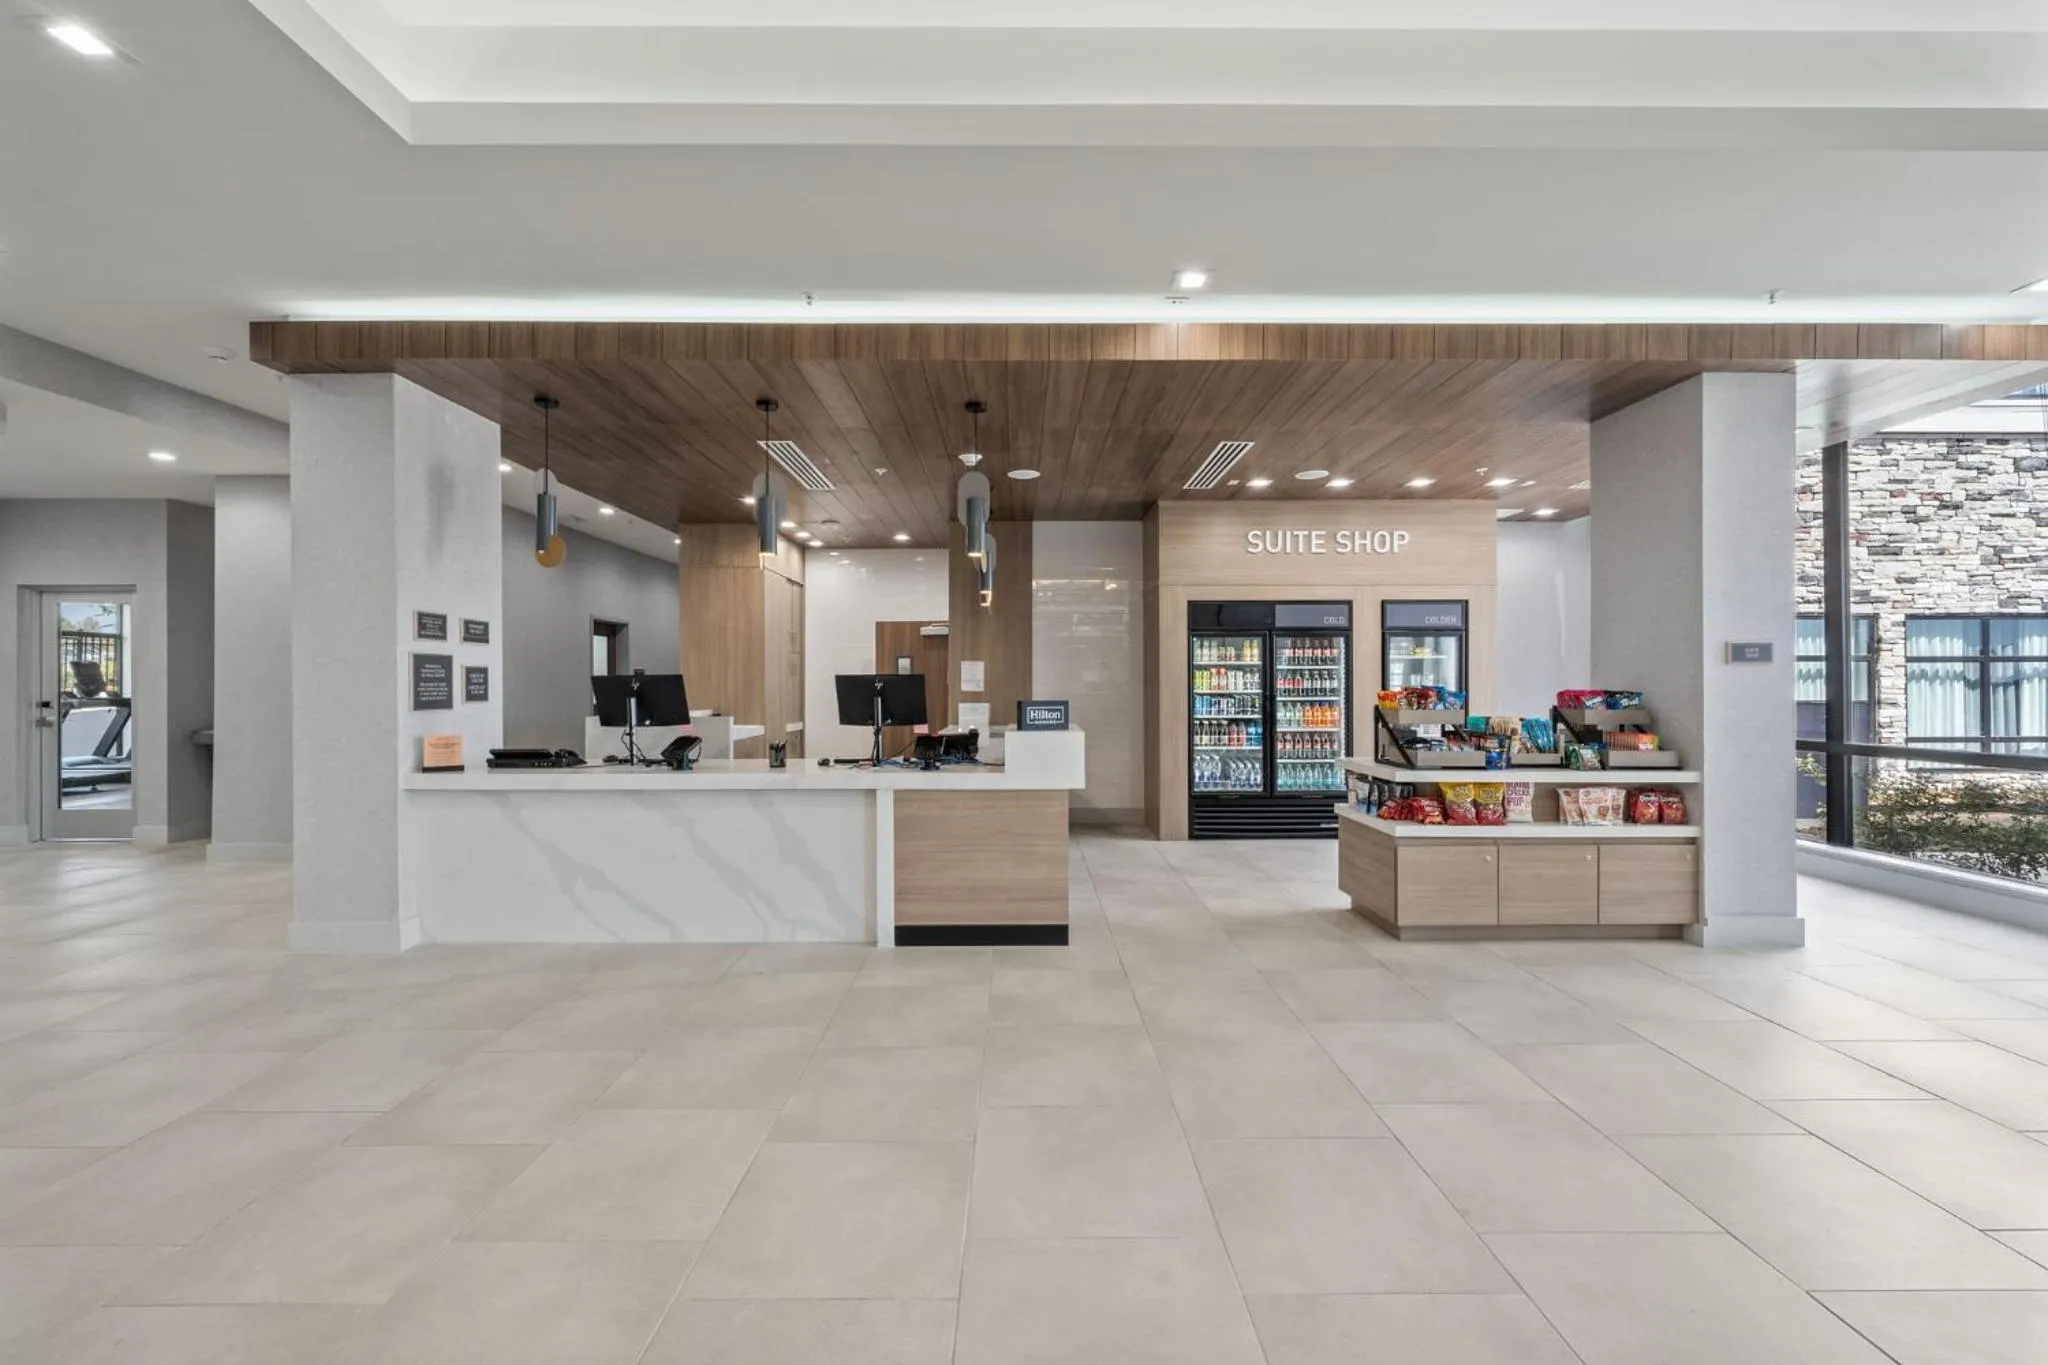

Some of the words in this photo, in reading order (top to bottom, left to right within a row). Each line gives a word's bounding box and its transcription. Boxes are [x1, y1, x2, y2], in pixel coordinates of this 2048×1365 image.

[1247, 530, 1327, 553] SUITE
[1336, 530, 1410, 553] SHOP
[1323, 616, 1345, 625] COLD
[1030, 709, 1061, 720] Hilton
